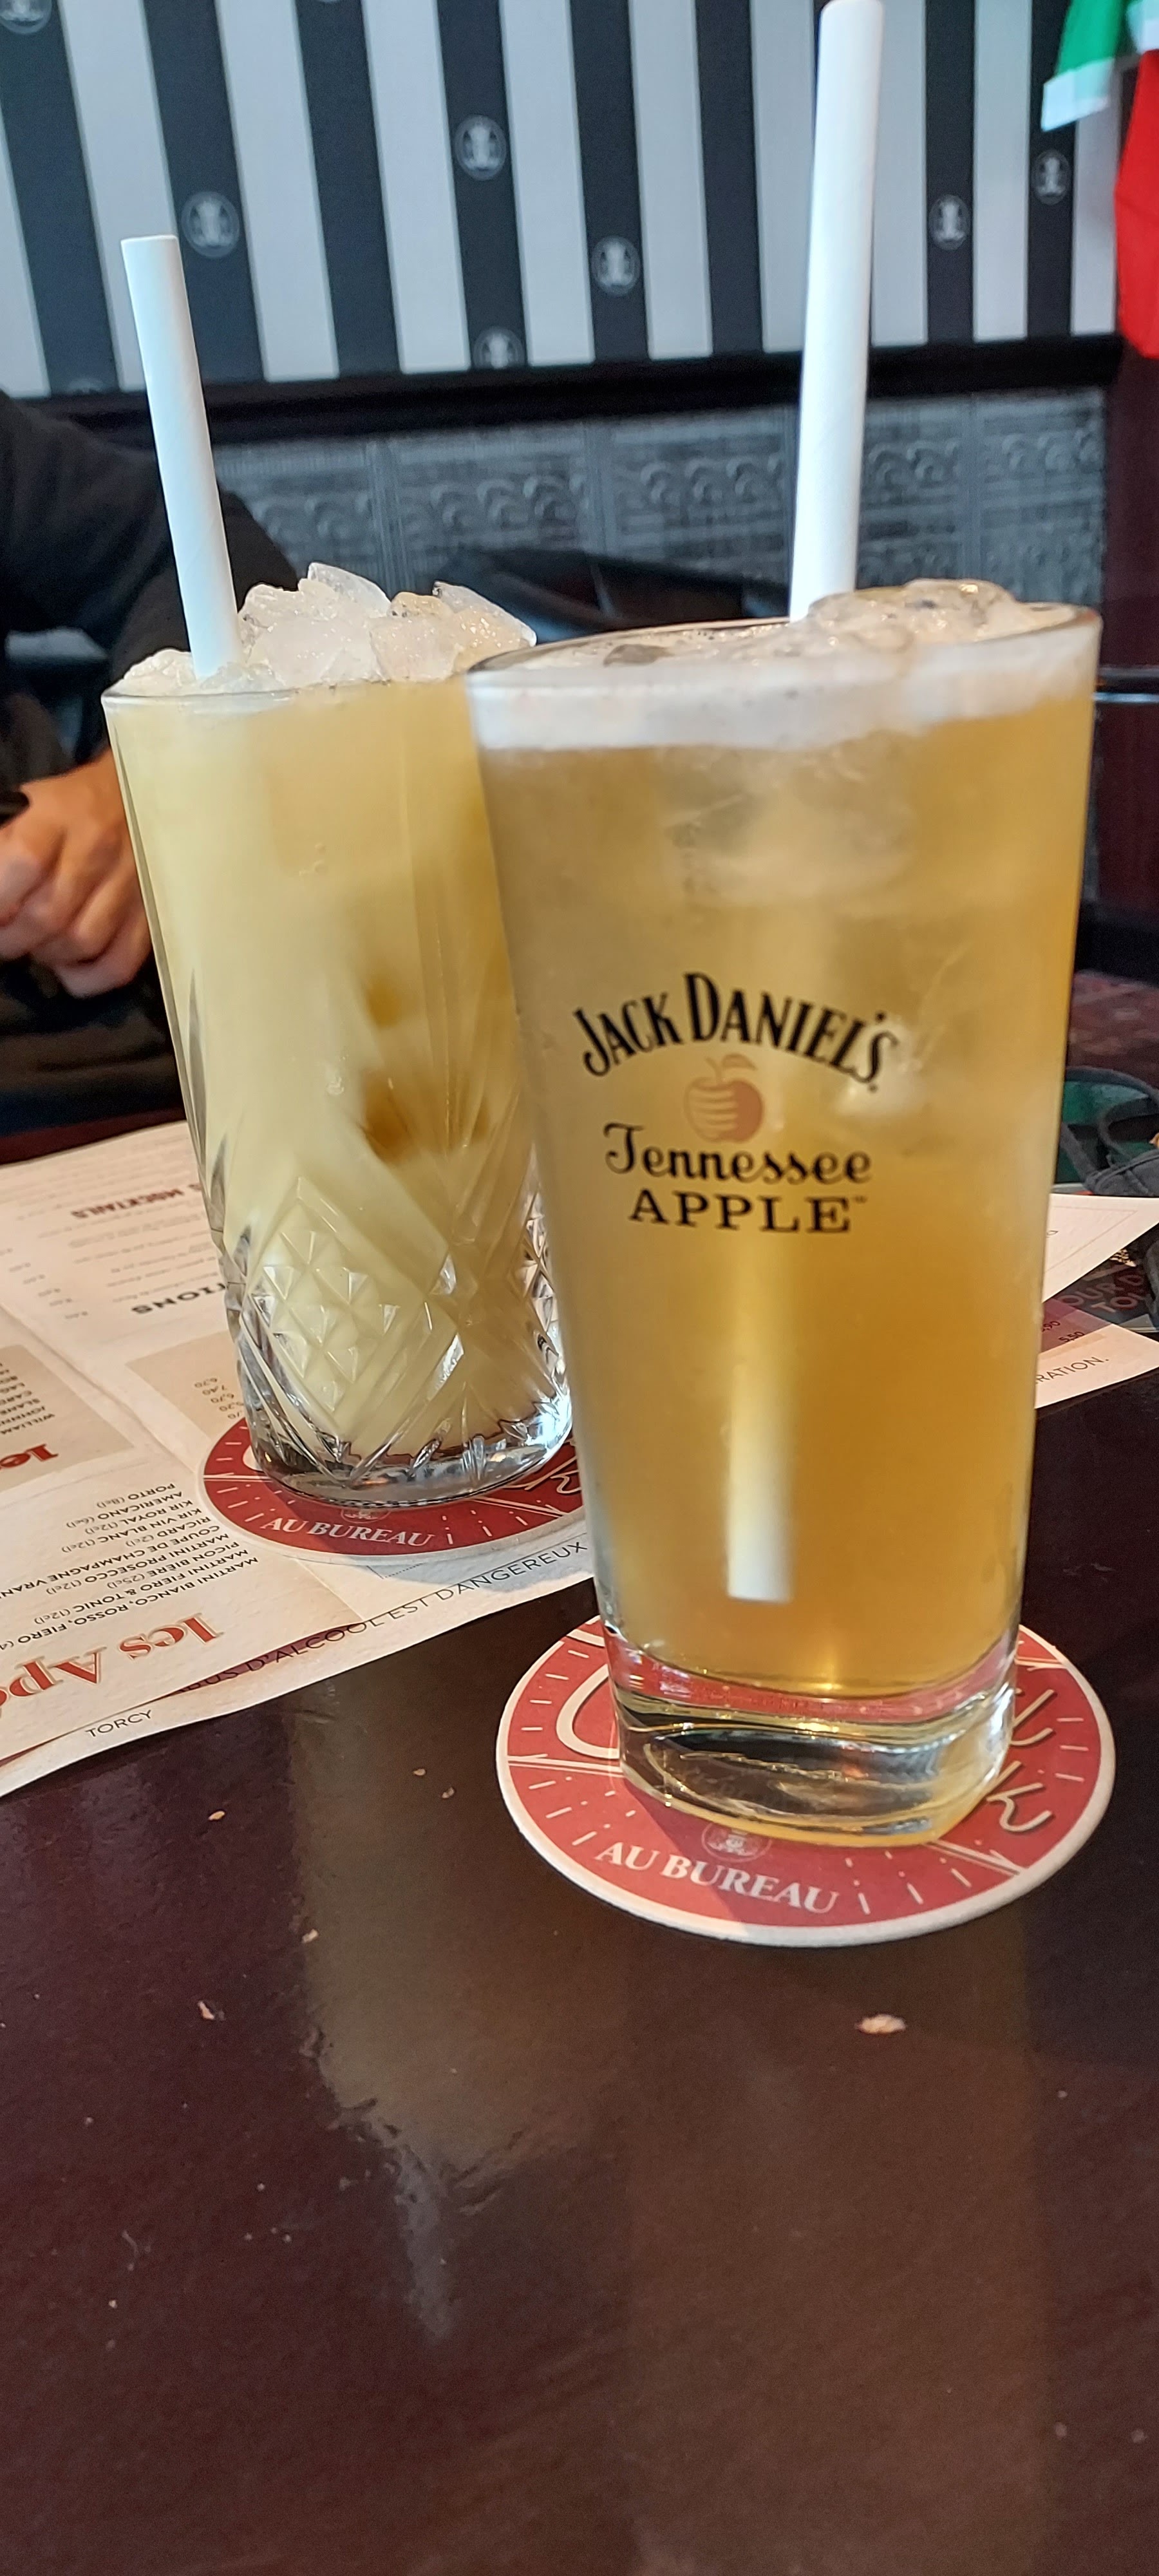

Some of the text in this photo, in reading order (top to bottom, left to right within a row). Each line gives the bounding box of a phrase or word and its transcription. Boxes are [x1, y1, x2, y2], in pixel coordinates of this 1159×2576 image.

[573, 991, 682, 1076] JACK
[603, 1122, 872, 1185] Tennessee
[127, 1483, 175, 1500] PORTO
[97, 1491, 182, 1520] AMERICANO
[169, 1500, 193, 1511] KIR
[178, 1508, 202, 1519] KIR
[120, 1508, 167, 1525] ROYAL
[149, 1517, 177, 1529] VIN
[97, 1526, 147, 1543] BLANC
[157, 1517, 211, 1537] RICARD
[169, 1525, 220, 1545] COUPE
[260, 1517, 435, 1546] AU BUREAU
[147, 1542, 169, 1553] DE
[192, 1542, 240, 1562] PICON
[46, 1533, 230, 1595] MARTINI PROSECCO (12cl)
[47, 1549, 146, 1582] CHAMPAGNE
[147, 1559, 191, 1577] BIÈRE
[188, 1549, 249, 1575] MARTINI
[197, 1557, 258, 1584] MARTINI
[140, 1573, 186, 1591] FIERO
[387, 1598, 429, 1620] EST
[434, 1541, 588, 1601] DANGEREUX
[72, 1593, 125, 1613] TONIC
[129, 1582, 195, 1605] BIANCO,
[34, 1609, 71, 1624] (12cl)
[68, 1604, 129, 1625] ROSSO,
[17, 1623, 68, 1643] FIERO
[118, 1613, 225, 1660] les
[85, 1710, 152, 1738] TORCY
[594, 1841, 840, 1914] AU BUREAU
